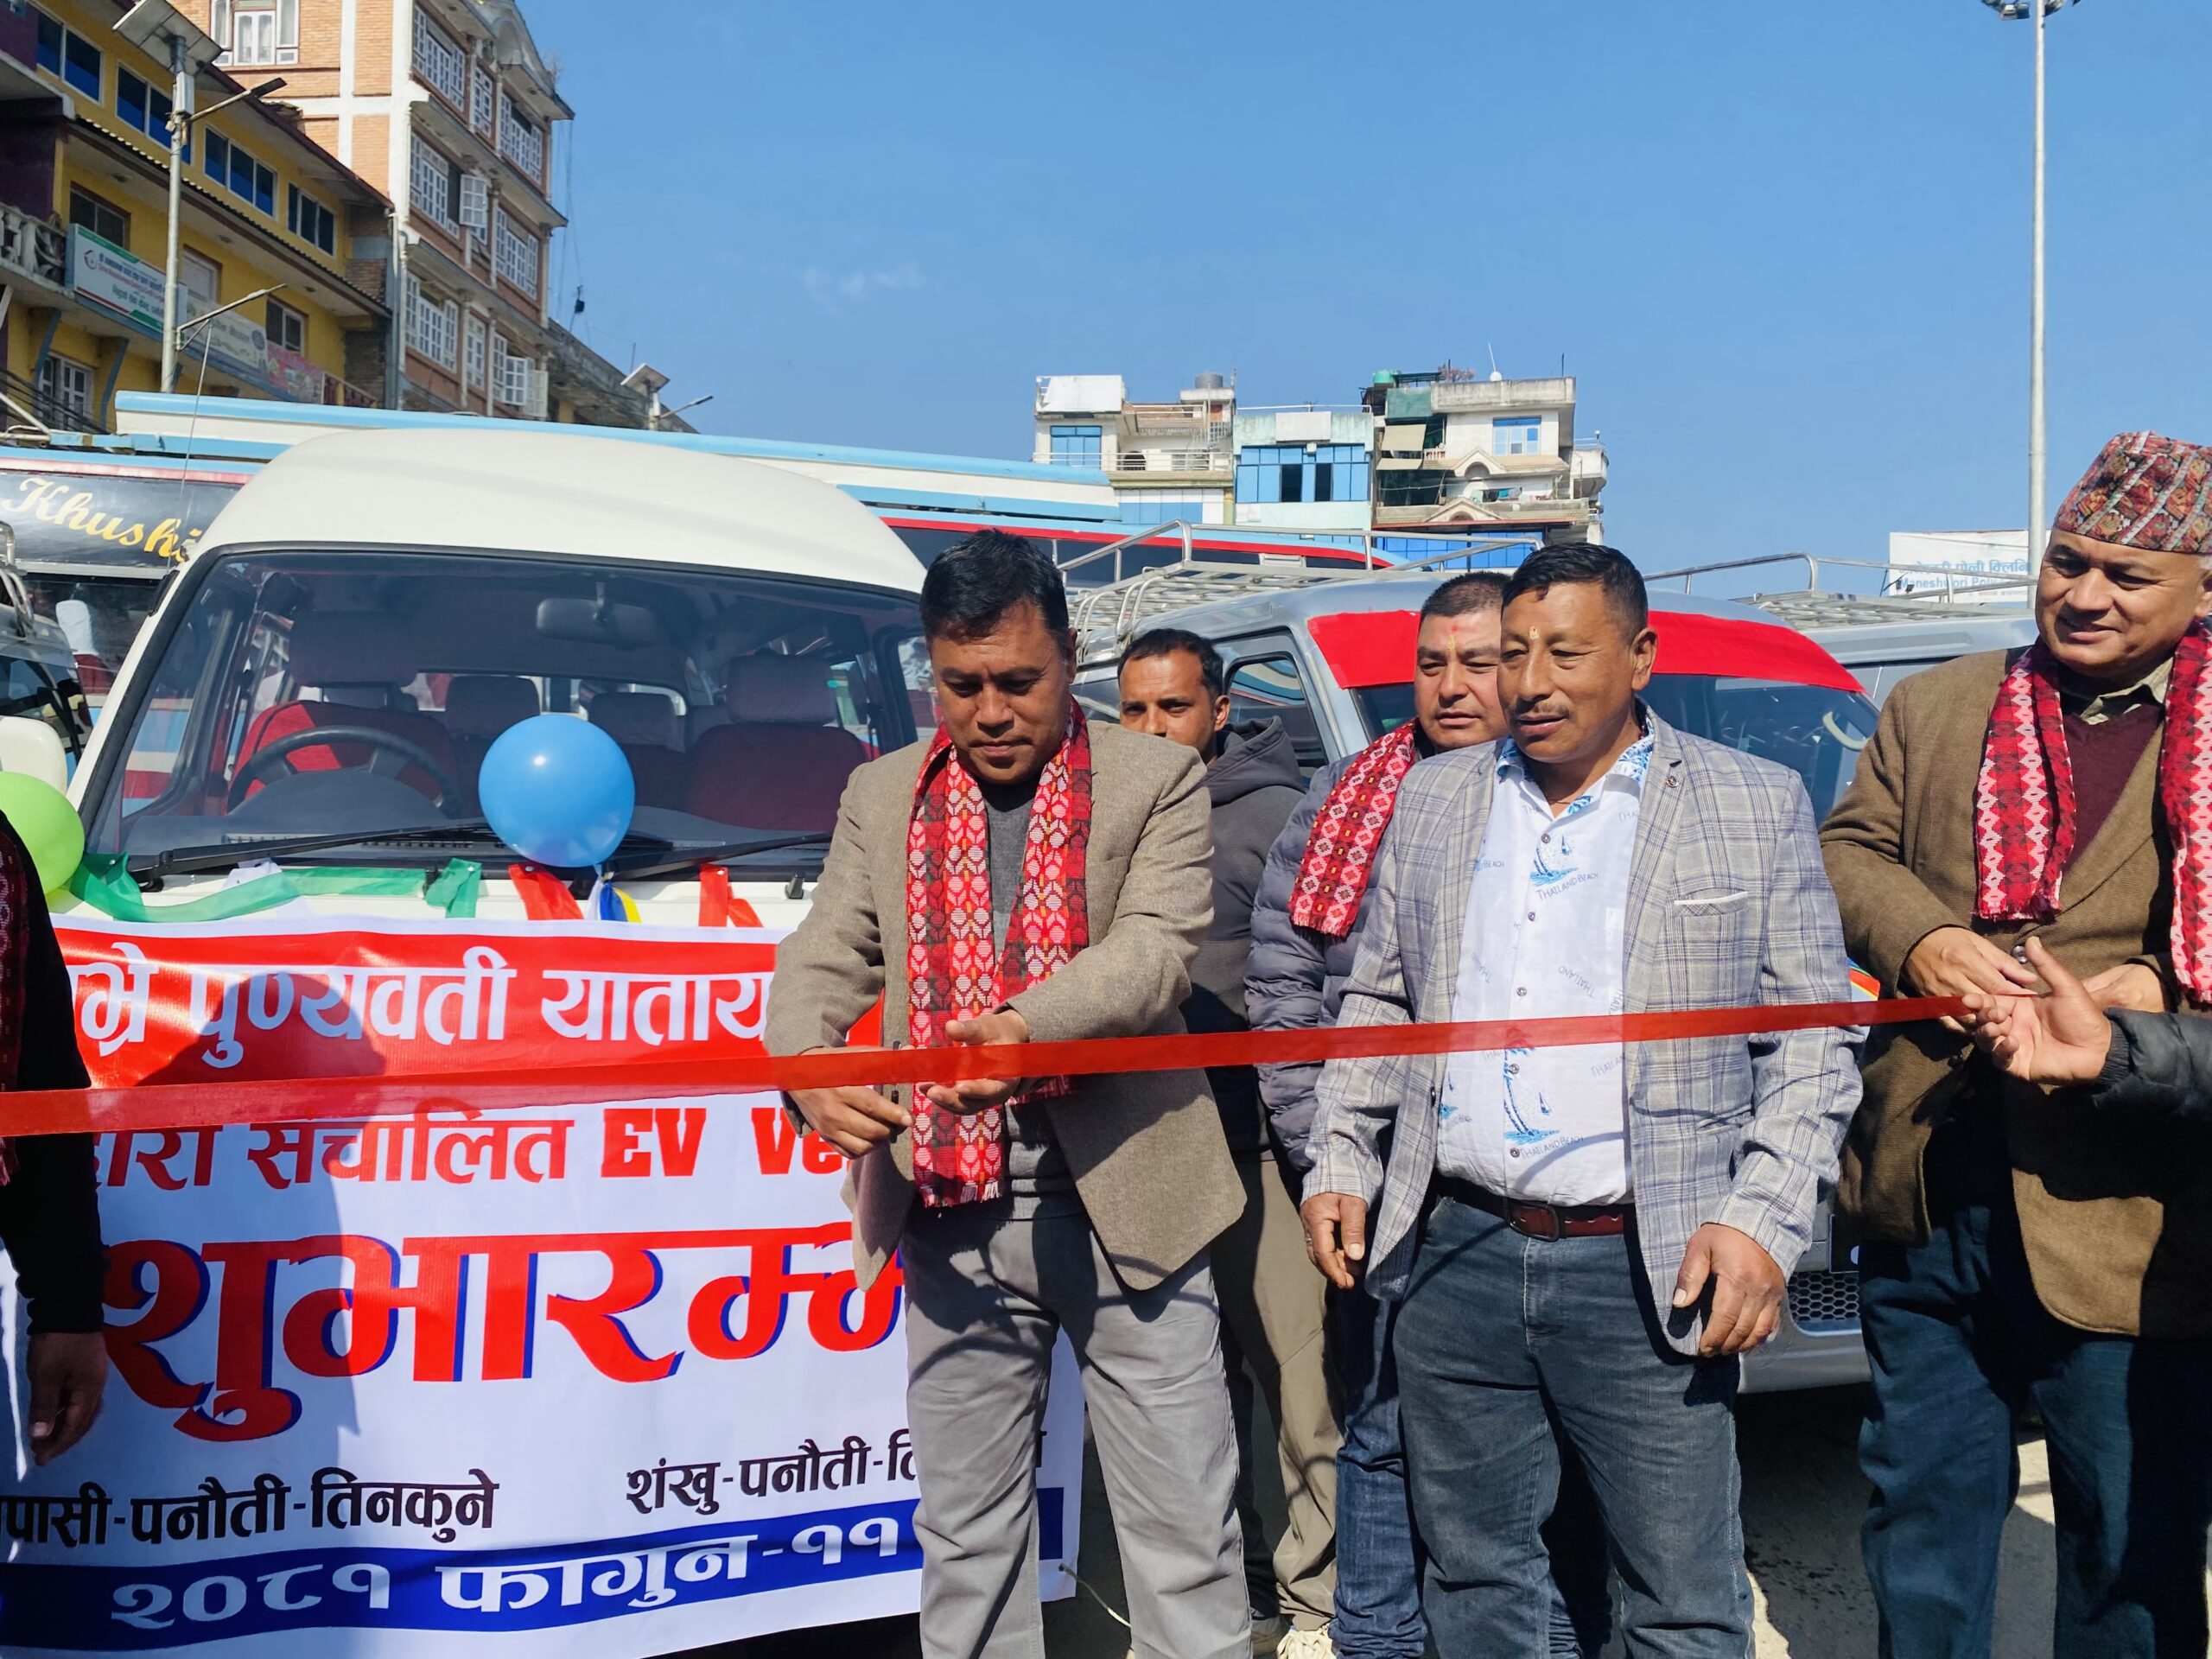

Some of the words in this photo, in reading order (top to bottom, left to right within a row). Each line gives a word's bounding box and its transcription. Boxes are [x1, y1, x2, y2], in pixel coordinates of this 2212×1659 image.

[188, 946, 517, 1068] पुण्यवती
[601, 1108, 707, 1178] EV
[751, 1107, 851, 1175] Ve
[111, 1564, 391, 1630] २०८१
